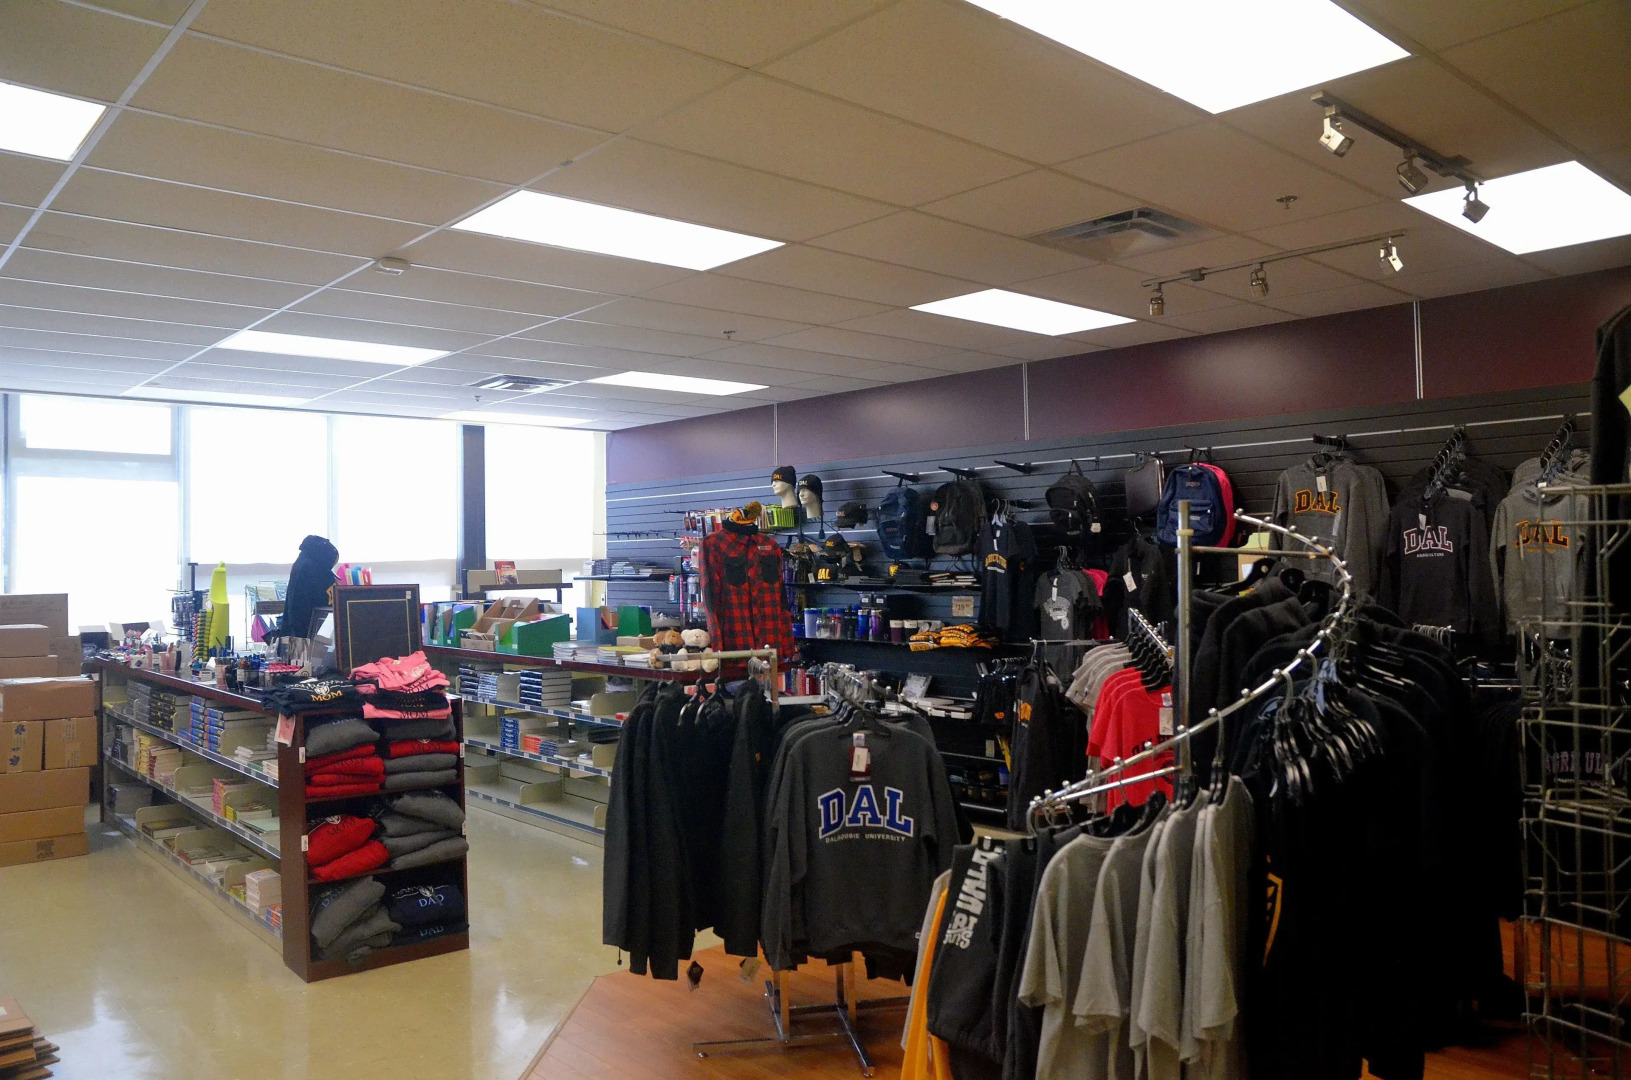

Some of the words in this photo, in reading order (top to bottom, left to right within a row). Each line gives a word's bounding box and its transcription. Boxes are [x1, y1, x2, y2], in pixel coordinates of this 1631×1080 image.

[1294, 489, 1342, 517] DAL
[1403, 525, 1454, 555] DAL
[1514, 518, 1570, 549] DAL
[310, 690, 344, 702] MOM
[817, 784, 914, 840] DAL
[864, 833, 906, 843] UNIVERSITY
